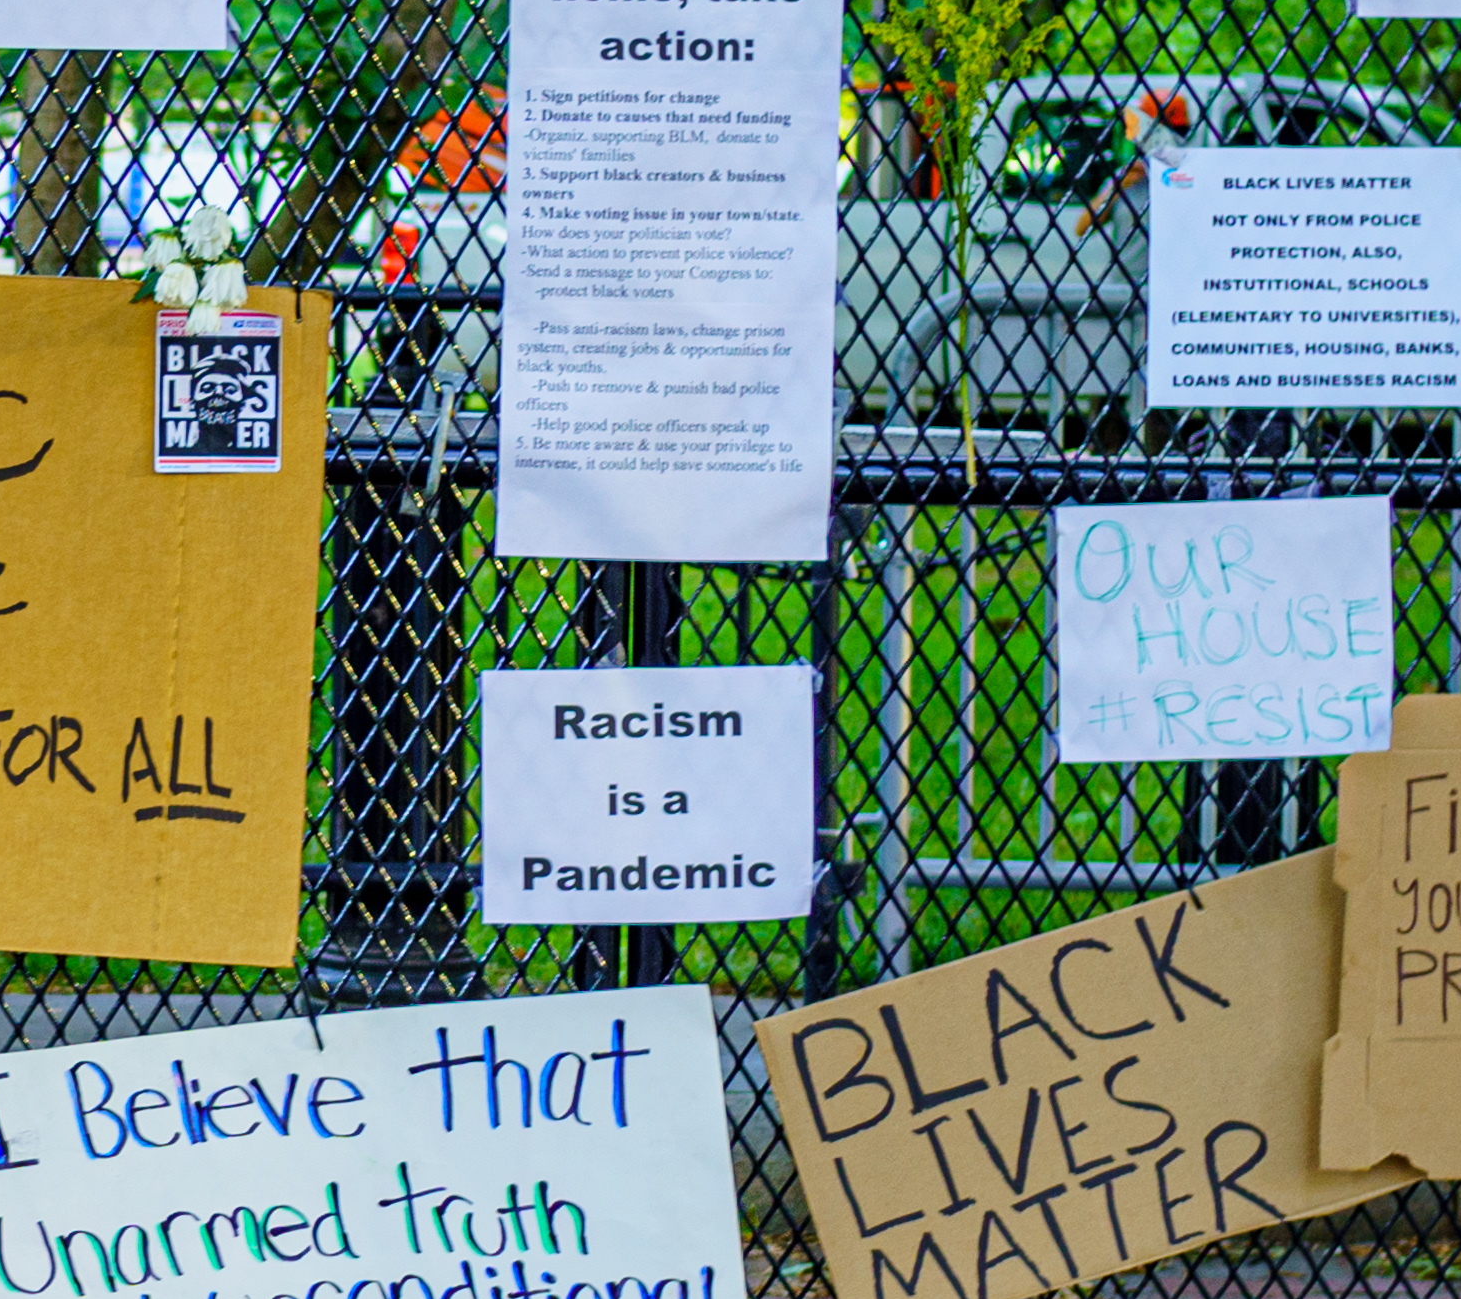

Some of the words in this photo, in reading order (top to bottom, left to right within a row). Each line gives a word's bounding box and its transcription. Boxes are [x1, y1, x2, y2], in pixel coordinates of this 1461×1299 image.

[600, 30, 754, 61] action:
[542, 90, 573, 104] Sign
[578, 91, 639, 105] petitions
[644, 90, 664, 103] for
[670, 92, 720, 105] change
[541, 110, 592, 123] Donate
[597, 111, 611, 123] to
[616, 113, 661, 123] causes
[666, 111, 695, 123] that
[699, 112, 731, 124] need
[736, 112, 791, 127] funding
[1224, 178, 1280, 189] BLACK
[1287, 178, 1334, 189] LIVES
[1341, 178, 1411, 189] MATTER
[1213, 215, 1247, 226] NOT
[1254, 215, 1299, 226] ONLY
[1306, 215, 1353, 226] FROM
[1360, 215, 1421, 226] POLICE
[1231, 247, 1346, 260] PROTECTION,
[1352, 247, 1402, 260] ALSO,
[1204, 279, 1342, 292] INSTUTITIONAL,
[1348, 279, 1429, 290] SCHOOLS
[1172, 311, 1292, 324] (ELEMENTARY
[1300, 311, 1322, 323] TO
[1329, 311, 1460, 325] UNIVERSITIES),
[1172, 343, 1299, 357] COMMUNITIES,
[1305, 343, 1389, 357] HOUSING,
[1396, 343, 1459, 357] BANKS,
[1173, 375, 1230, 387] LOANS
[1236, 375, 1271, 387] AND
[1278, 375, 1385, 387] BUSINESSES
[1392, 375, 1457, 387] RACISM
[554, 703, 743, 740] Racism
[122, 715, 233, 803] ALL
[608, 784, 645, 816] is
[663, 790, 690, 814] a
[523, 854, 776, 891] Pandemic
